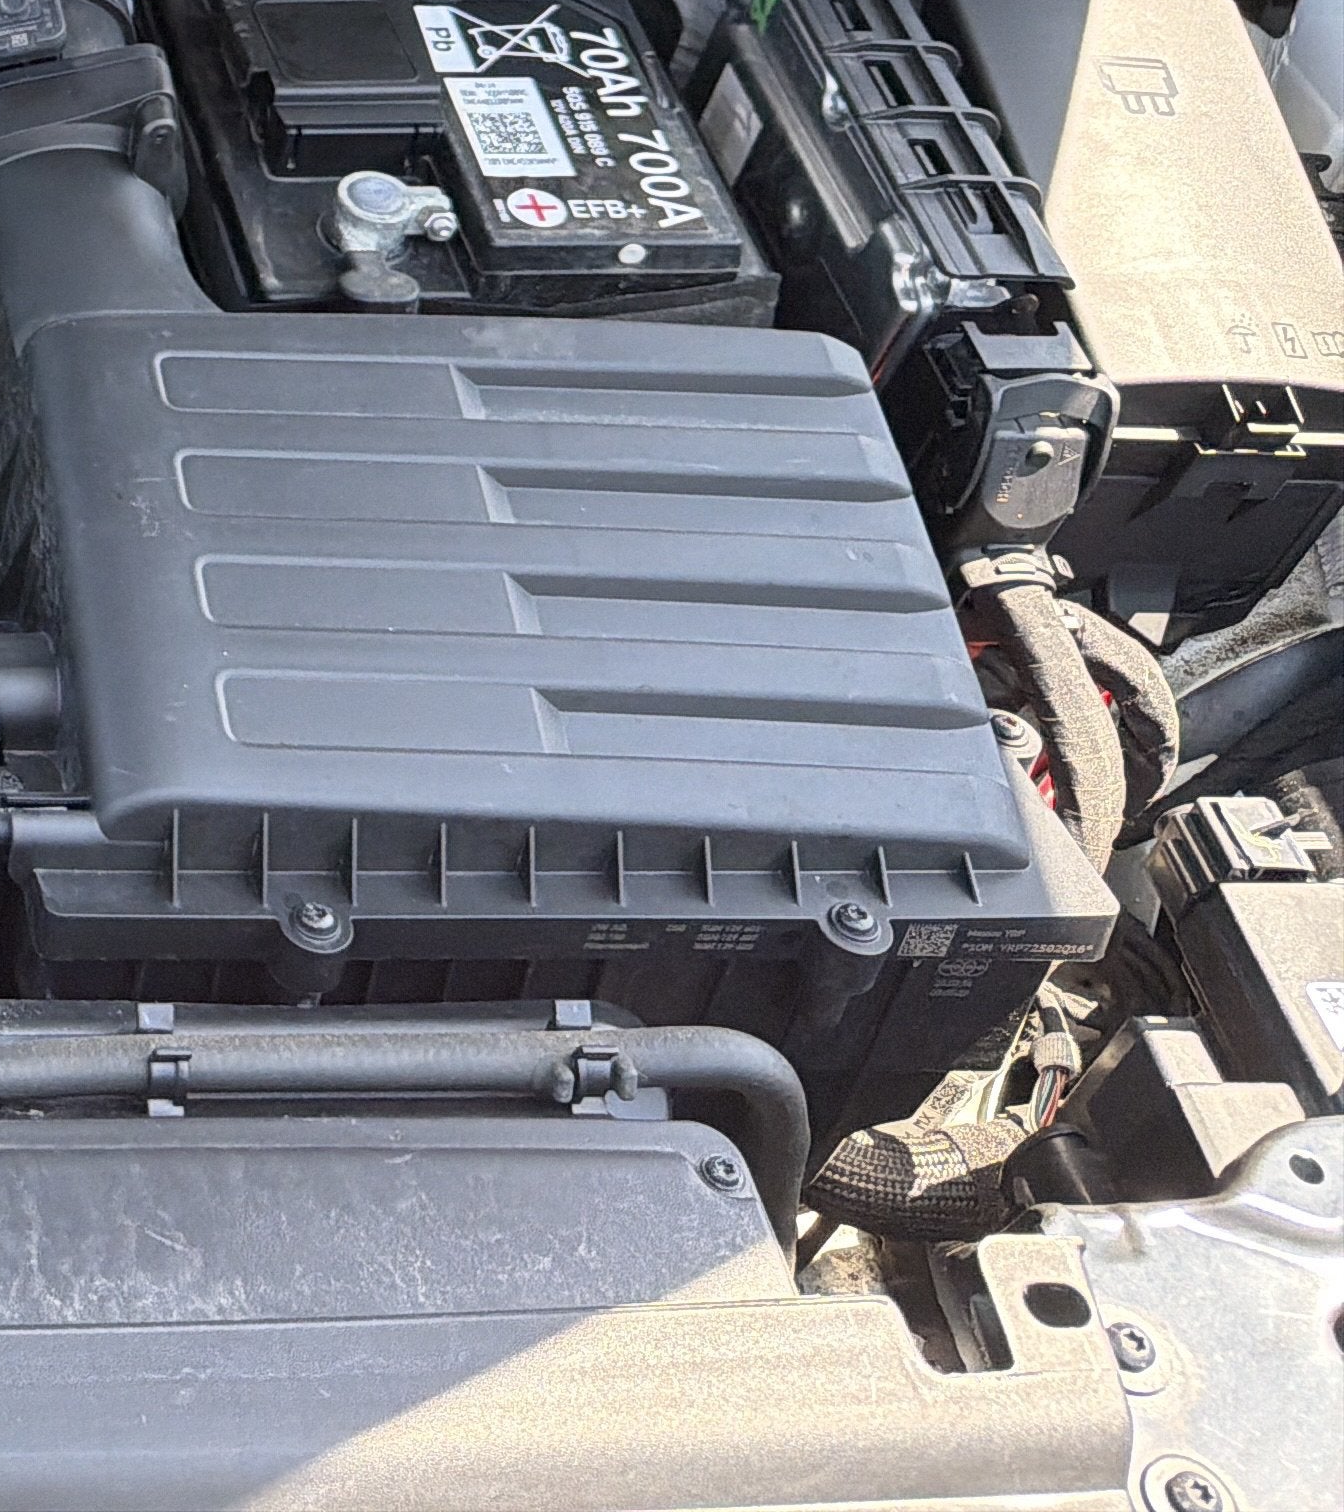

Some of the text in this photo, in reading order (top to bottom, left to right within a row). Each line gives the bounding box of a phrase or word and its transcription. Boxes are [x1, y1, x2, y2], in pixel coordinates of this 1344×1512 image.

[425, 27, 456, 52] Pb
[568, 27, 704, 228] 70Ah 700A
[566, 199, 647, 219] EFB+
